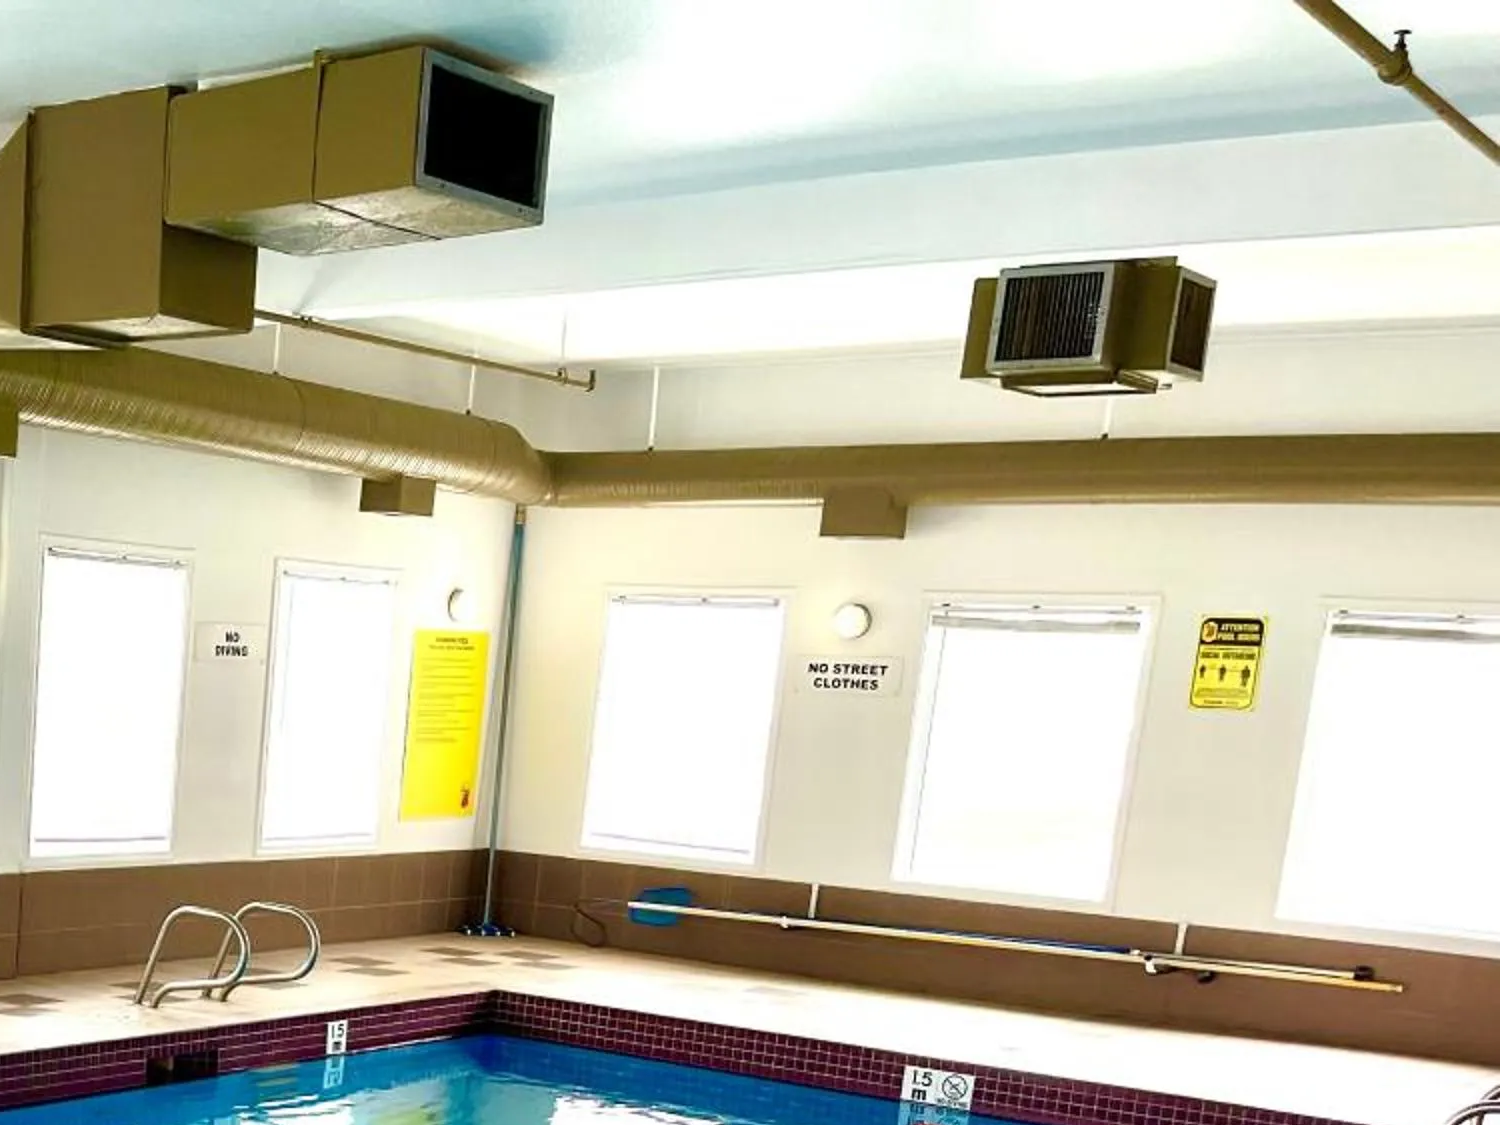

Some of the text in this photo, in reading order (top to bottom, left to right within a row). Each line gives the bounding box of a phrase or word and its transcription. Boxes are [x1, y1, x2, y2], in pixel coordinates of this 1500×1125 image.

[225, 631, 240, 643] NO
[215, 645, 249, 657] DIVING
[808, 662, 889, 677] NO STREET
[813, 677, 879, 691] CLOTHES
[912, 1088, 926, 1100] m
